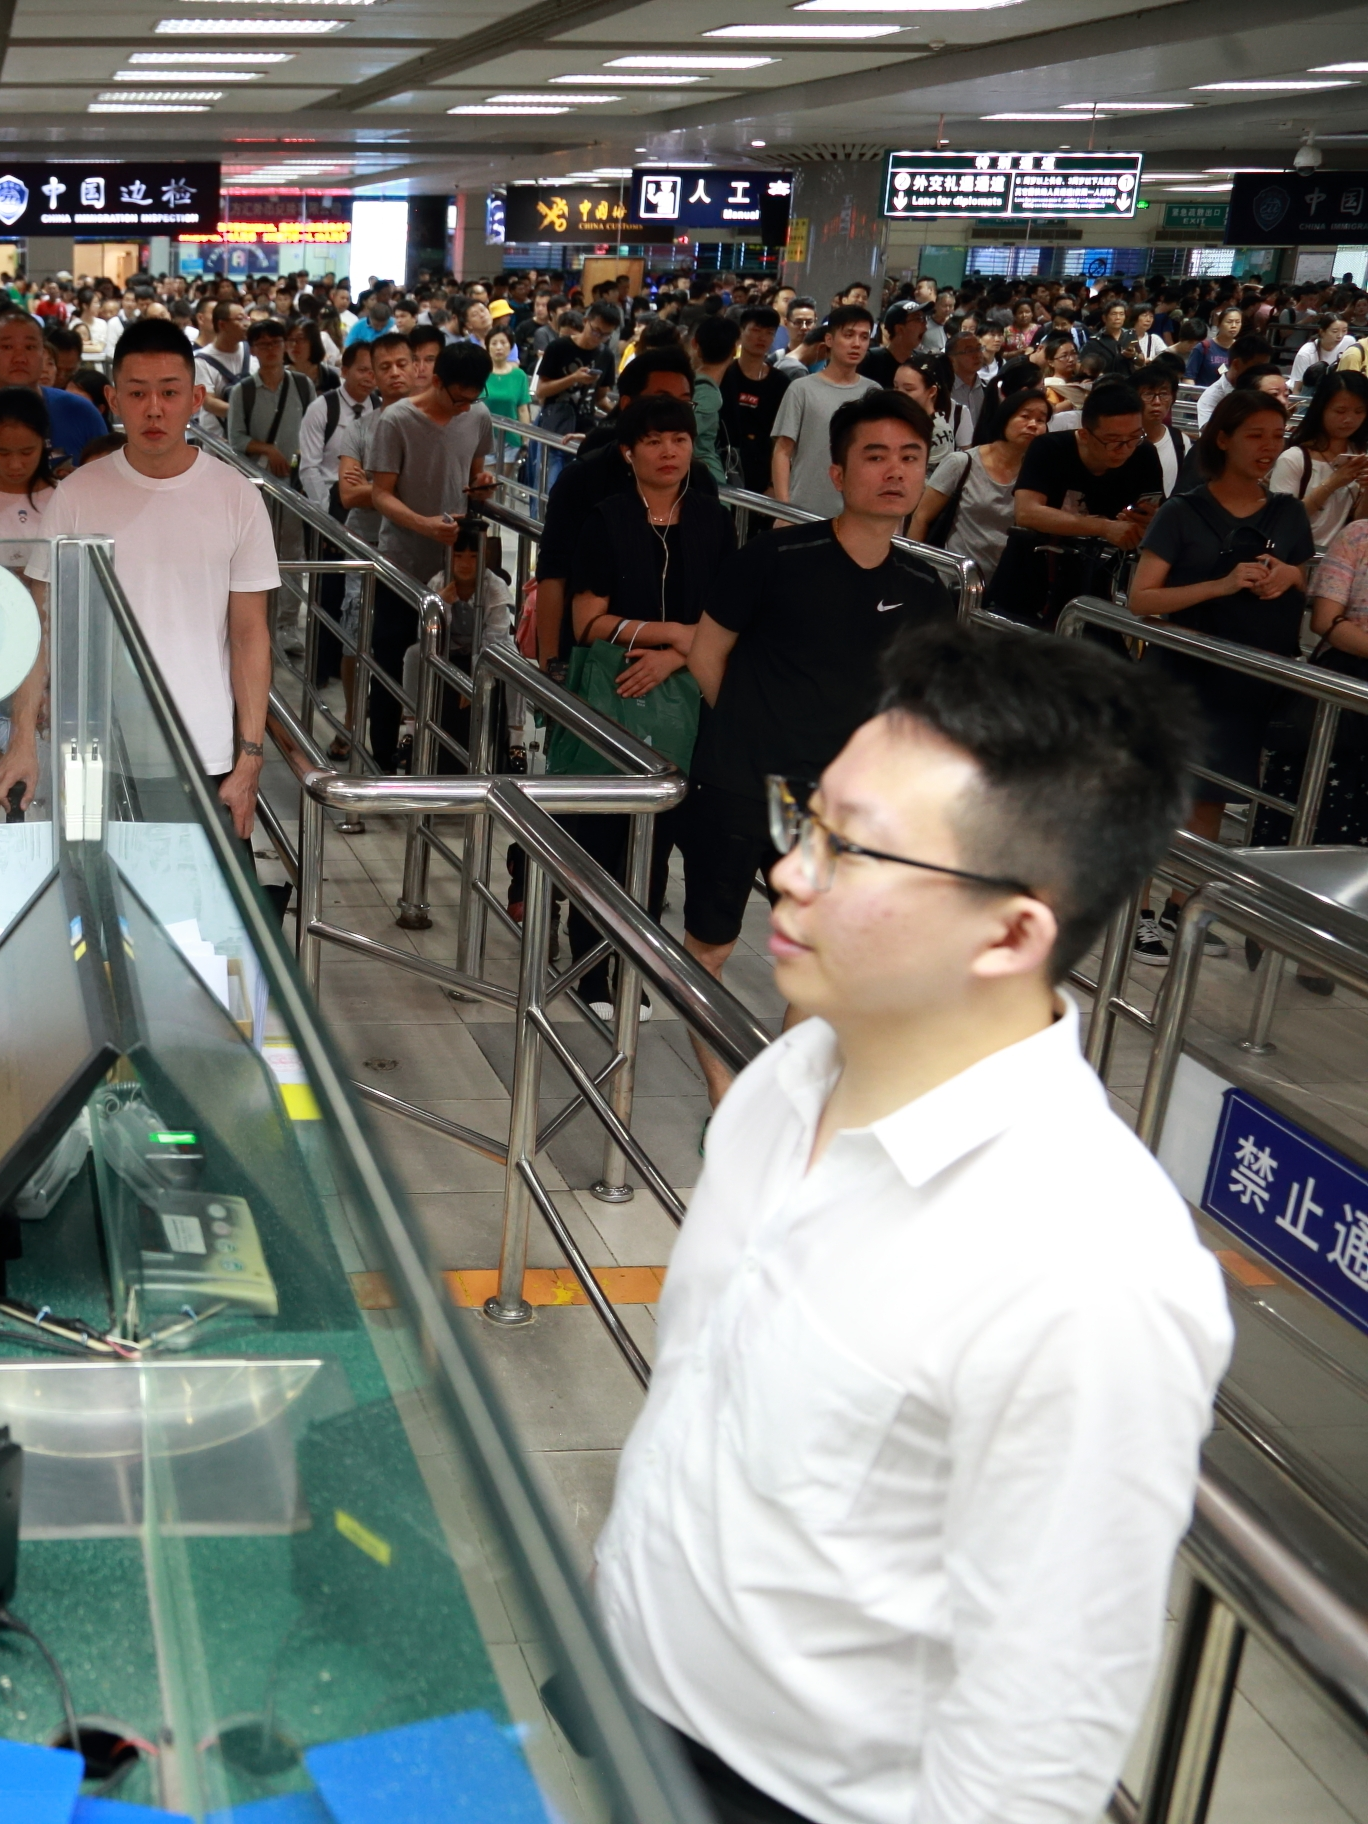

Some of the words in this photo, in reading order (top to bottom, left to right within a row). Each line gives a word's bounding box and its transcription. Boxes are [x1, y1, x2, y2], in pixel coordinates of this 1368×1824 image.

[975, 156, 1056, 170] 特别通道
[913, 174, 1006, 193] 外交礼遇通道
[912, 196, 936, 206] Lane
[937, 195, 952, 206] for
[952, 196, 1003, 208] diplomats
[1304, 186, 1365, 217] 中国
[40, 213, 72, 224] CHINA
[74, 213, 139, 224] IMMIGRATION
[140, 213, 200, 224] INSPECTION
[723, 209, 760, 220] Manual
[578, 222, 604, 231] CHINA
[1299, 223, 1326, 231] CHINA
